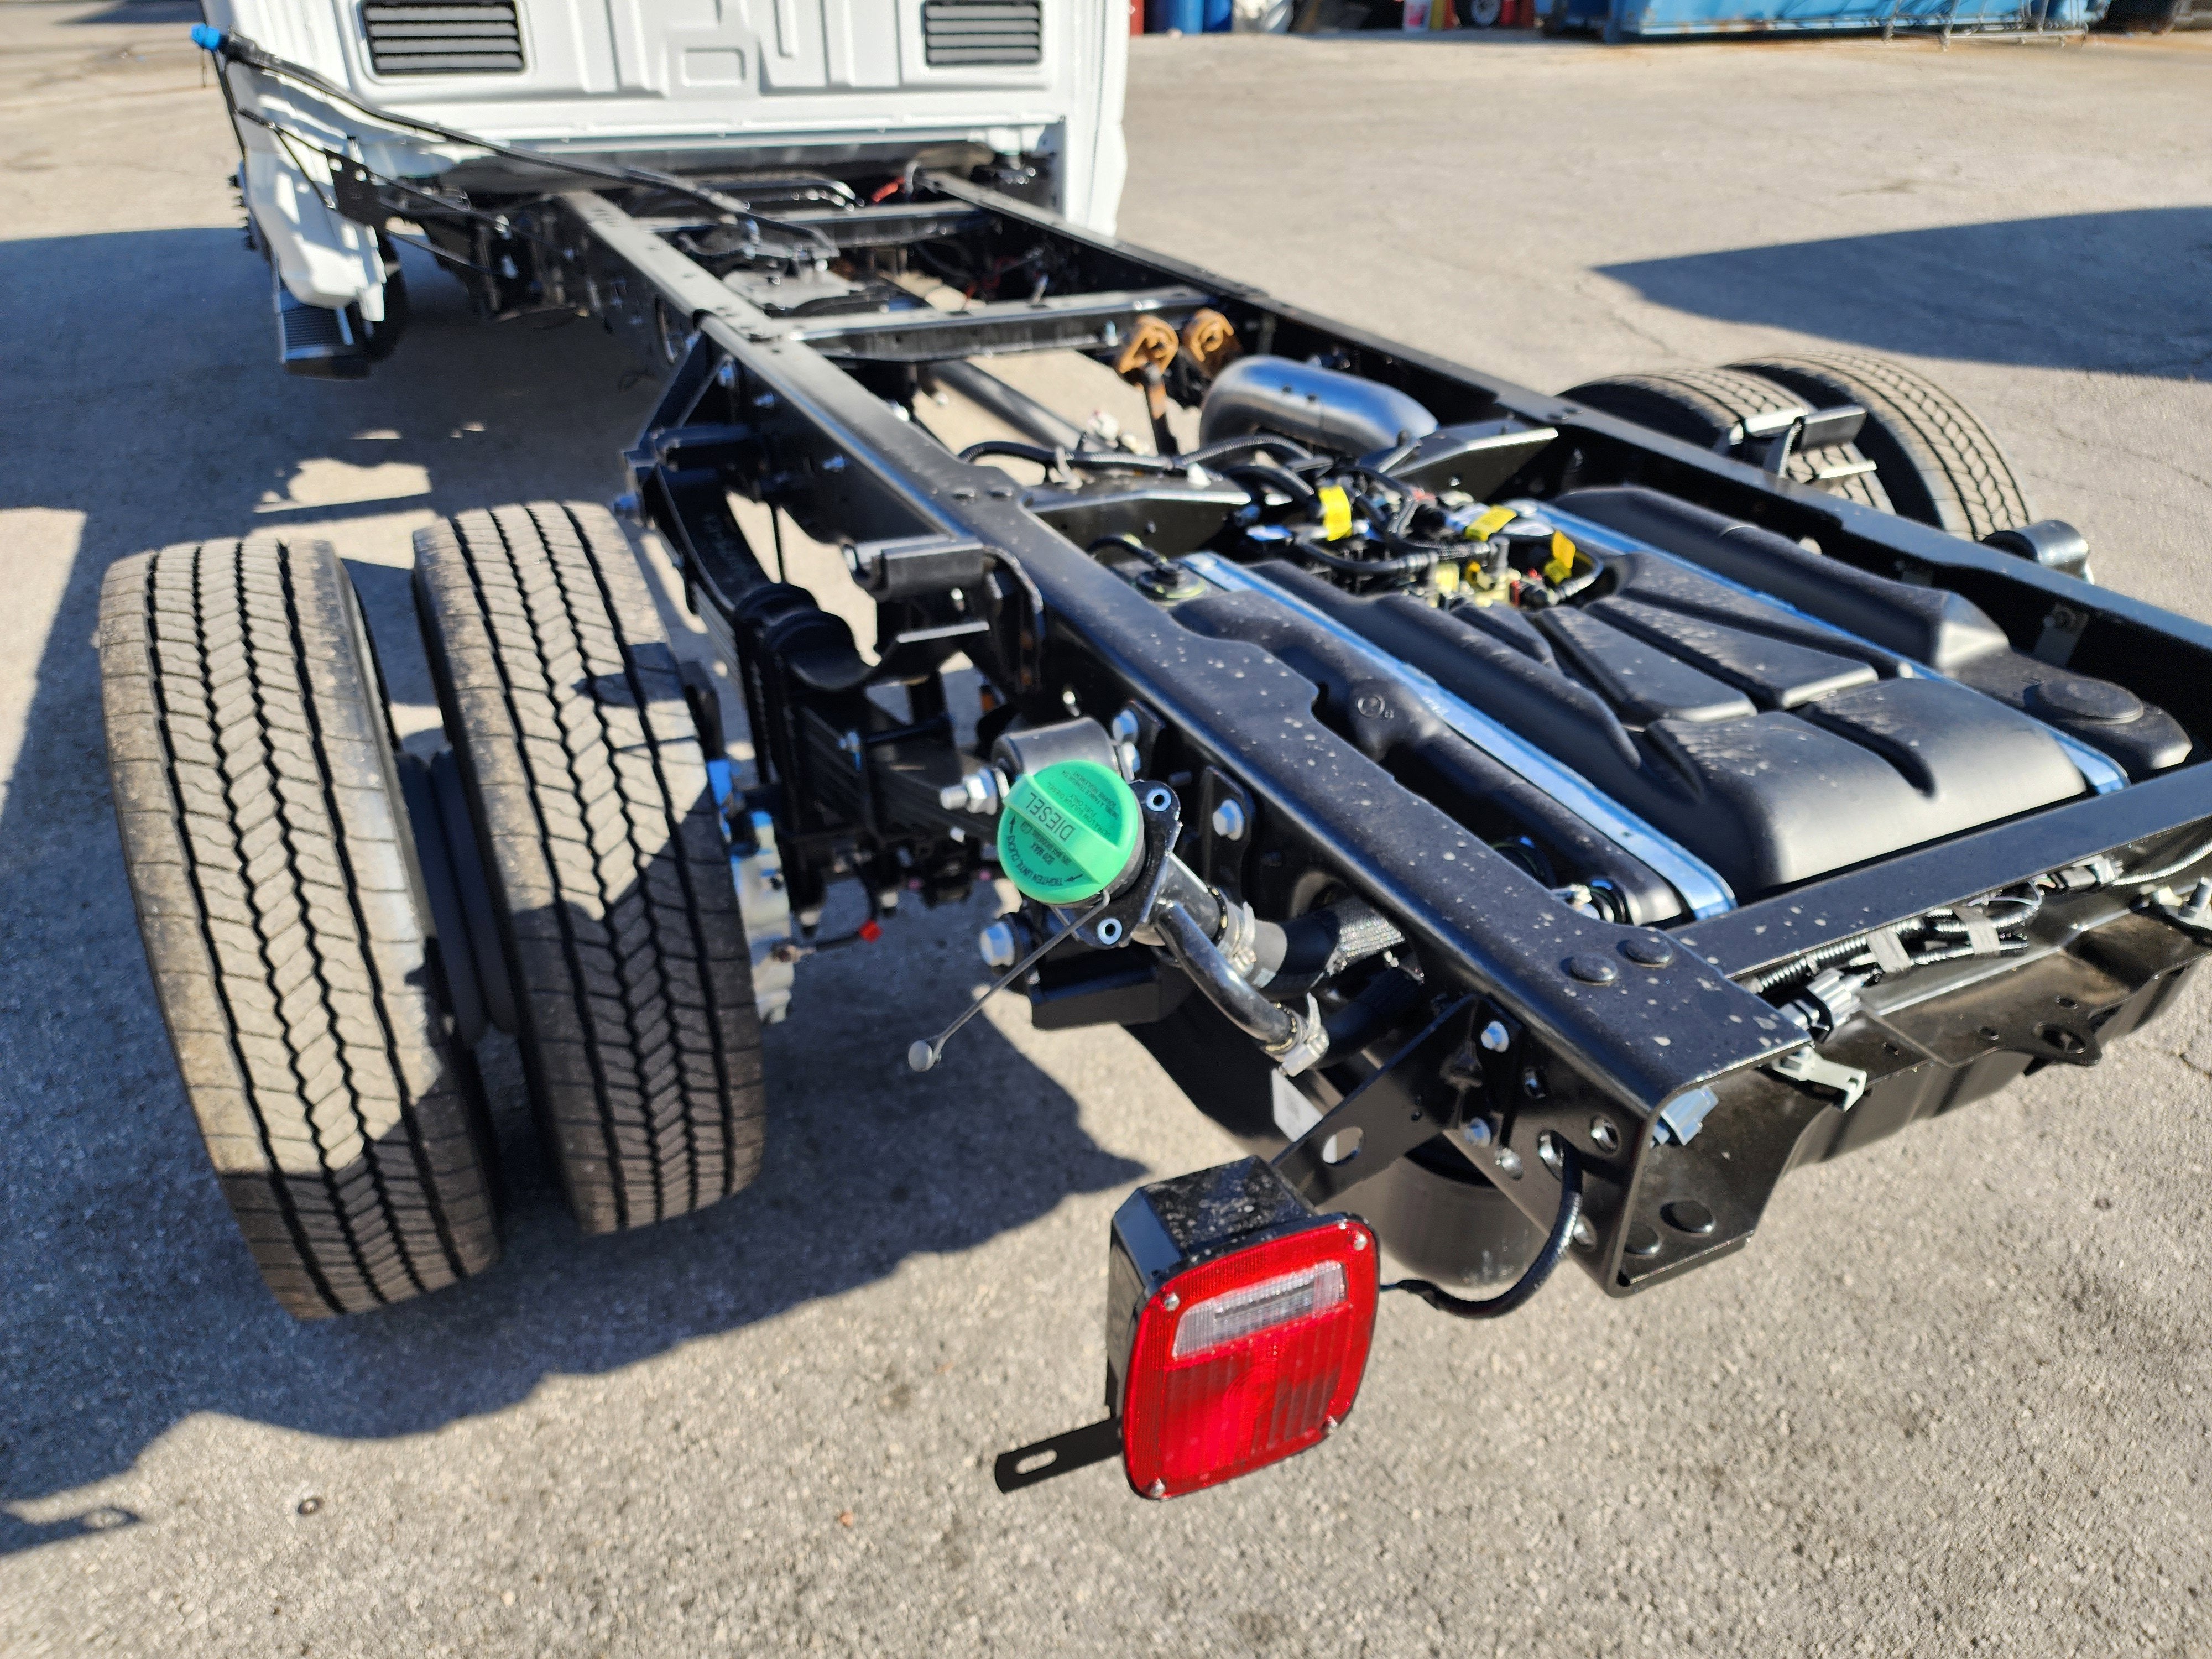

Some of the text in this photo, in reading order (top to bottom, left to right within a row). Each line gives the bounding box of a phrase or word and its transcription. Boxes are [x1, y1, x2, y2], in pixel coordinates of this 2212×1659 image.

[1069, 792, 1097, 817] FUEL ONLY
[1021, 792, 1076, 842] DIESEL
[1082, 812, 1096, 826] LOW
[1029, 842, 1045, 857] MAX
